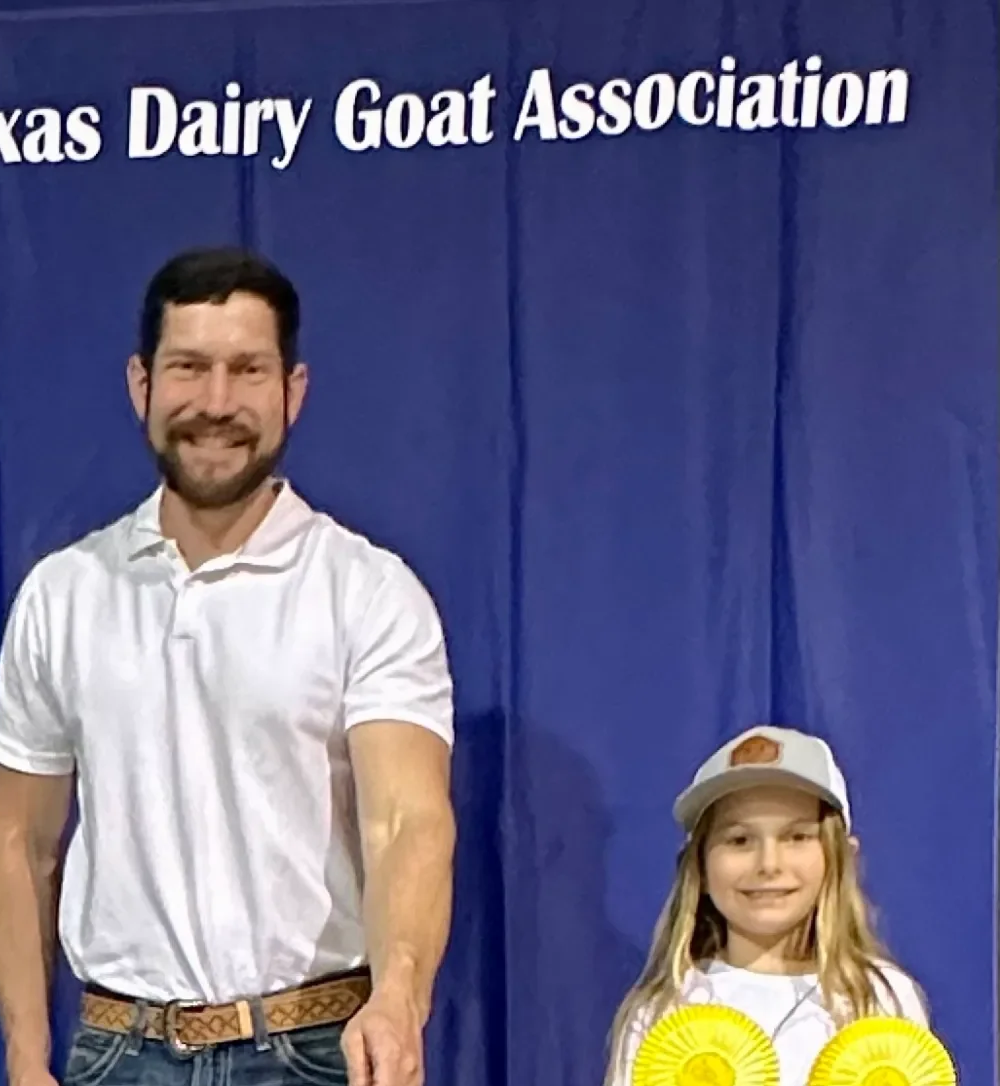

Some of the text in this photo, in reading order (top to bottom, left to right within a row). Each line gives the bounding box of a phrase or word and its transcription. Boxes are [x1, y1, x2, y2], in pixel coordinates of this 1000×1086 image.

[127, 82, 314, 171] Dairy
[334, 74, 497, 152] Goat
[513, 55, 909, 142] Association
